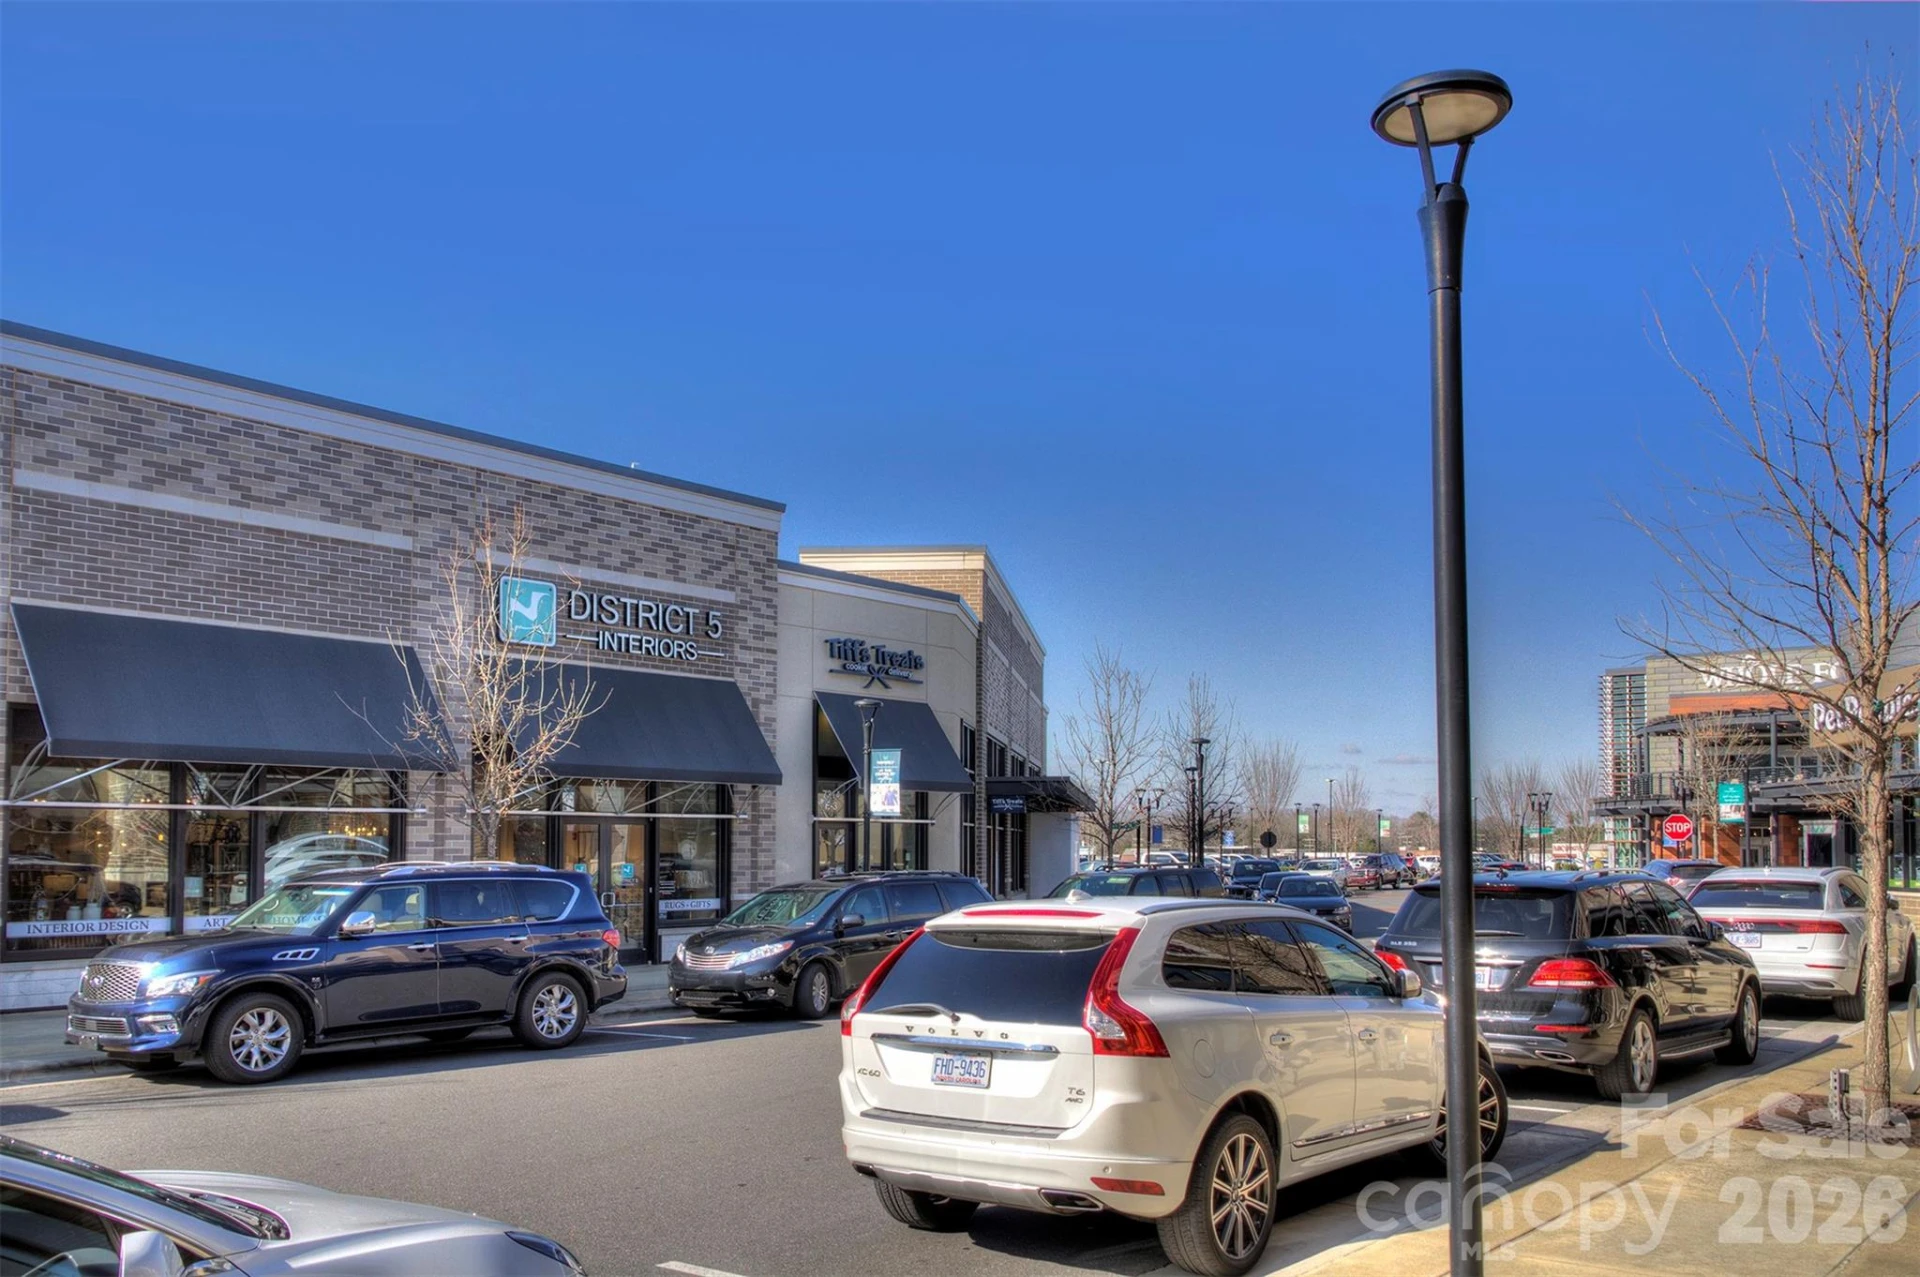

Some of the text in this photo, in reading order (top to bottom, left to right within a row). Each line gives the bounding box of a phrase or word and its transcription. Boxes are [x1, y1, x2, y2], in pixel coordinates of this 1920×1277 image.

[569, 590, 722, 639] DISTRICT 5
[598, 630, 698, 661] INTERIORS
[824, 638, 924, 670] Tiff's Treats
[1665, 822, 1691, 833] STOP
[664, 900, 711, 909] RUGS GIFTS
[26, 919, 150, 935] INTERIOR DESIGN
[203, 917, 229, 928] ART
[905, 1025, 1009, 1040] VOLVO
[857, 1068, 881, 1078] XC60
[934, 1057, 987, 1079] FHD-9436
[1068, 1087, 1086, 1096] T6
